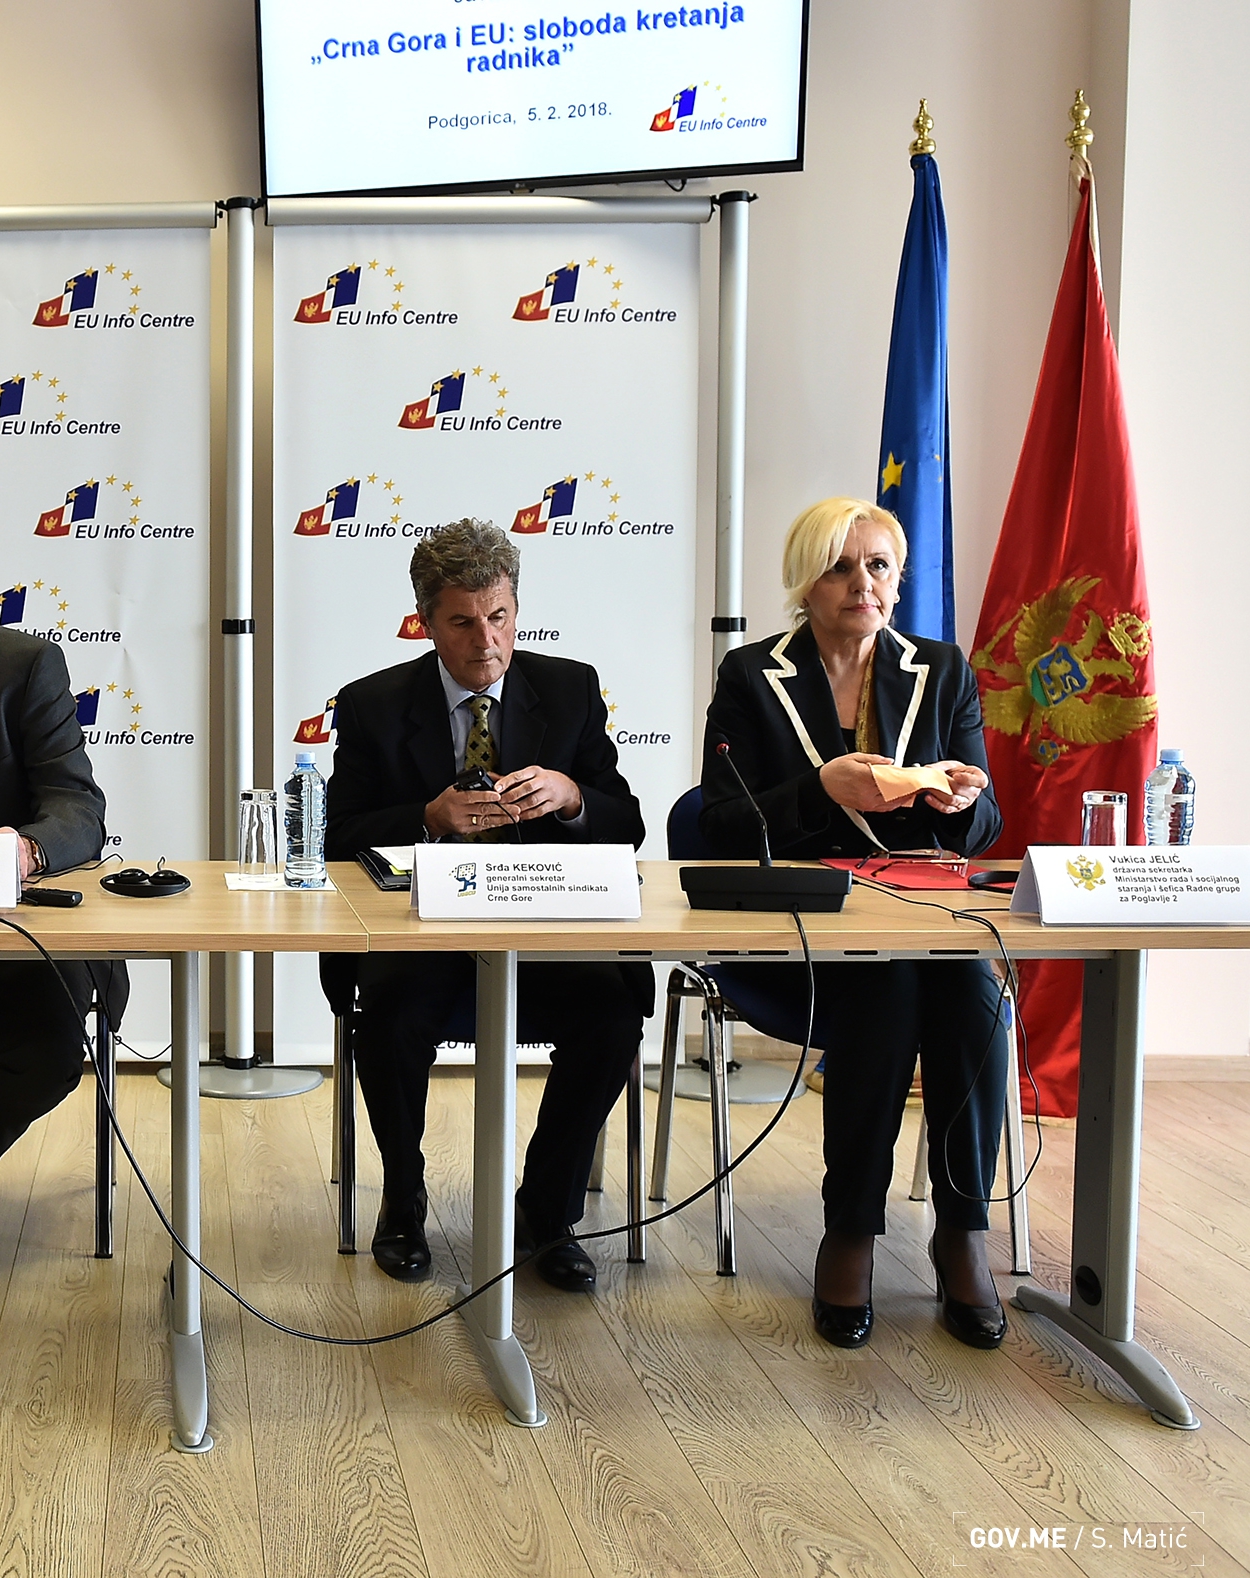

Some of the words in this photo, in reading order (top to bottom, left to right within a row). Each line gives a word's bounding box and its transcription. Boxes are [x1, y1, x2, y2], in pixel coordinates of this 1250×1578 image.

[387, 31, 447, 54] Gora
[455, 27, 462, 48] i
[470, 24, 516, 47] EU:
[523, 14, 627, 42] sloboda
[636, 4, 745, 33] kretanja
[427, 111, 517, 131] Podgorica,
[527, 106, 544, 122] 5.
[547, 105, 563, 121] 2.
[567, 102, 613, 119] 2018.
[679, 119, 698, 133] EU
[699, 117, 724, 131] Info
[726, 116, 767, 130] Centre
[75, 315, 99, 328] EU
[103, 314, 134, 328] Info
[141, 314, 194, 328] Centre
[337, 311, 361, 325] EU
[366, 311, 397, 325] Info
[403, 311, 458, 324] Centre
[555, 309, 579, 323] EU
[584, 308, 615, 323] Info
[622, 308, 676, 322] Centre
[2, 421, 25, 434] EU
[30, 421, 61, 435] Info
[67, 421, 120, 434] Centre
[76, 525, 99, 539] EU
[104, 524, 135, 538] Info
[141, 525, 194, 538] Centre
[335, 524, 361, 538] EU
[364, 523, 397, 538] Info
[553, 522, 577, 536] EU
[582, 521, 613, 535] Info
[619, 521, 673, 535] Centre
[67, 629, 121, 642] Centre
[105, 731, 136, 744] Info
[141, 731, 194, 744] Centre
[616, 730, 671, 744] Centre
[1108, 854, 1146, 864] Vukica
[1148, 853, 1181, 864] JELIĆ
[485, 863, 510, 872] Srđa
[513, 861, 563, 872] KEKOVIĆ
[1112, 866, 1146, 874] državna
[1148, 866, 1193, 874] sekretarka
[486, 874, 528, 883] generalni
[529, 874, 566, 882] sekretar
[1115, 875, 1168, 883] Ministarstvo
[1169, 875, 1189, 883] rada
[1195, 875, 1240, 884] socijalnog
[487, 884, 510, 893] Unija
[511, 884, 566, 892] samostalnih
[568, 884, 609, 892] sindikata
[1117, 885, 1152, 894] staranja
[1158, 884, 1185, 892] šefica
[1215, 886, 1241, 894] grupe
[487, 894, 509, 902] Crne
[510, 894, 533, 902] Gore
[1131, 894, 1171, 904] Poglavlje
